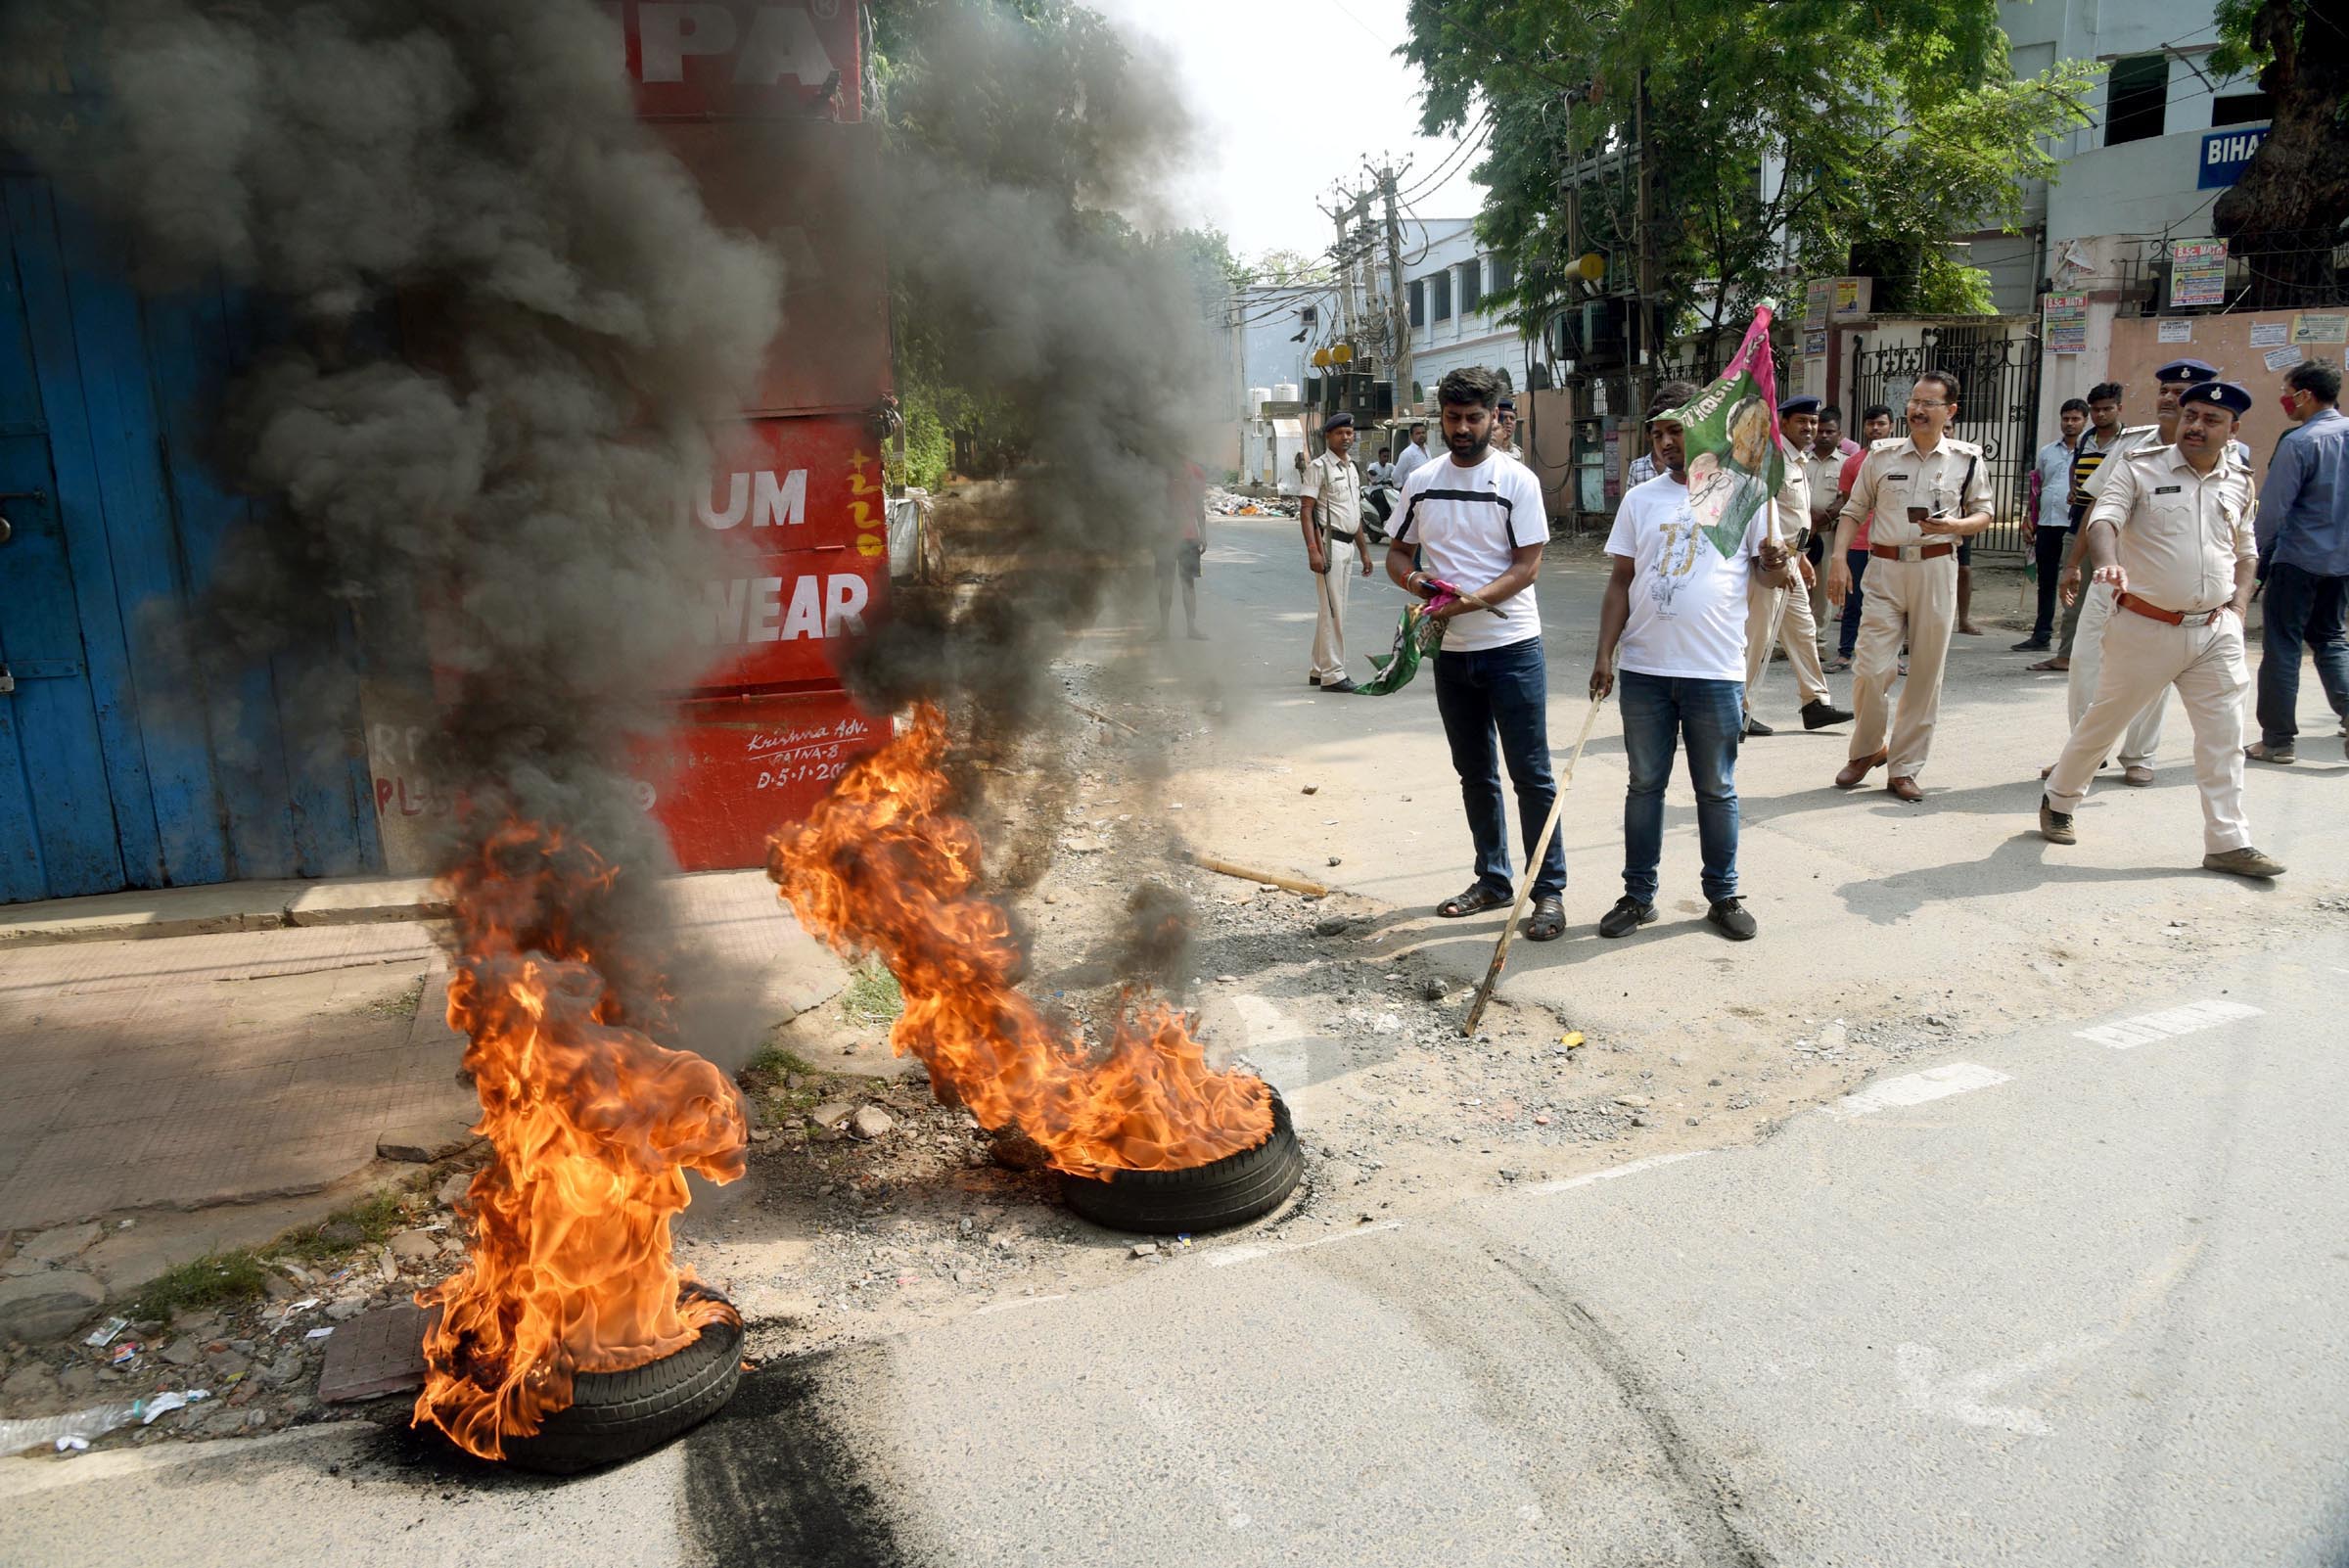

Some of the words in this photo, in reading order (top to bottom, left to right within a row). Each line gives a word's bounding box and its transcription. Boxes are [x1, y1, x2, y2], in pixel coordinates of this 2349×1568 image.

[2207, 133, 2267, 164] BIHA
[2200, 245, 2223, 254] MATH
[2065, 297, 2084, 306] MATH
